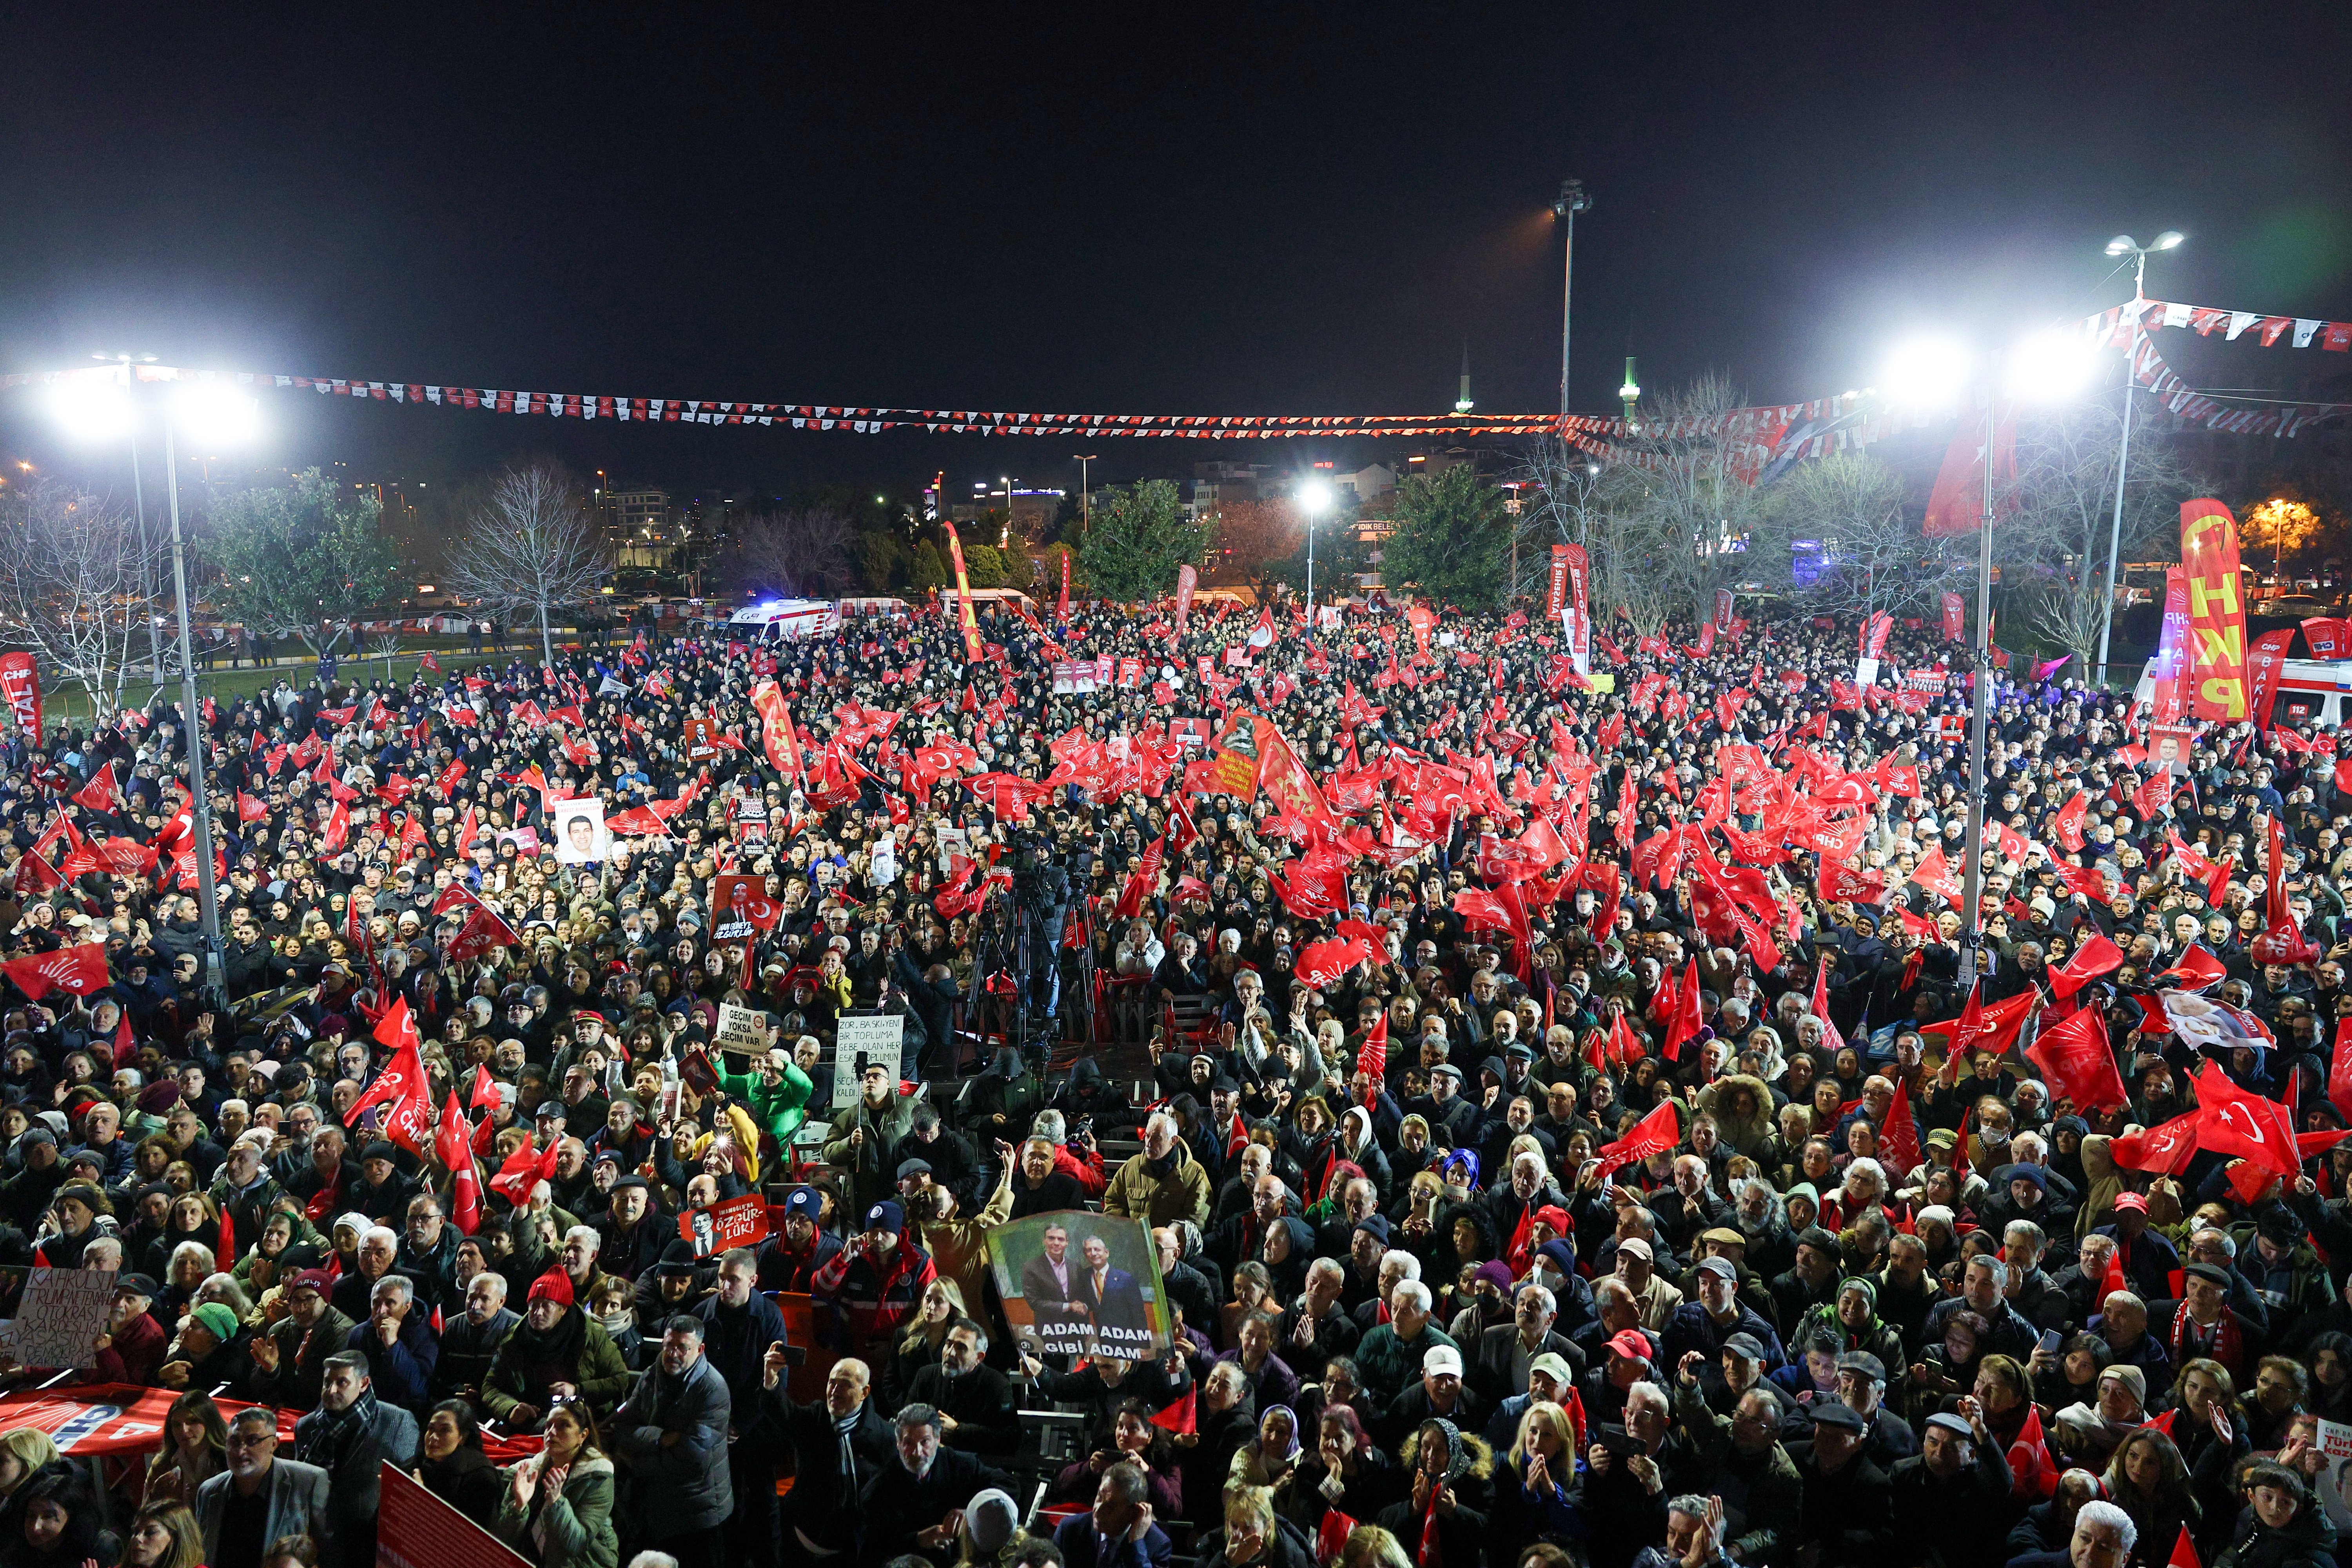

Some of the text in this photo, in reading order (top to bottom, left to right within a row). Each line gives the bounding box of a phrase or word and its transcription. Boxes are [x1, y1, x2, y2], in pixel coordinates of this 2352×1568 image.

[2261, 643, 2280, 652] CHP
[4, 668, 31, 681] CHP
[9, 684, 36, 740] RTAL
[828, 796, 848, 804] CHP
[1835, 886, 1867, 897] CHP
[730, 921, 752, 930] GÜNEY'E
[730, 1010, 751, 1023] GEÇİM
[728, 1020, 752, 1034] YOKSA
[839, 1021, 858, 1029] ZOR,
[720, 1031, 760, 1046] SEÇİM VAR
[855, 1031, 894, 1040] TOPLUMA
[838, 1043, 858, 1051] GEBE
[867, 1053, 898, 1062] OPLUMUN
[399, 1110, 422, 1143] CHP
[719, 1202, 754, 1216] İMAMOĞLU'NA
[716, 1207, 763, 1231] ÖZGÜR-
[726, 1220, 754, 1240] LÜK!
[1025, 1322, 1154, 1341] 2 ADAM ADAM
[1045, 1340, 1084, 1354] GİBİ
[1090, 1343, 1142, 1359] ADAM
